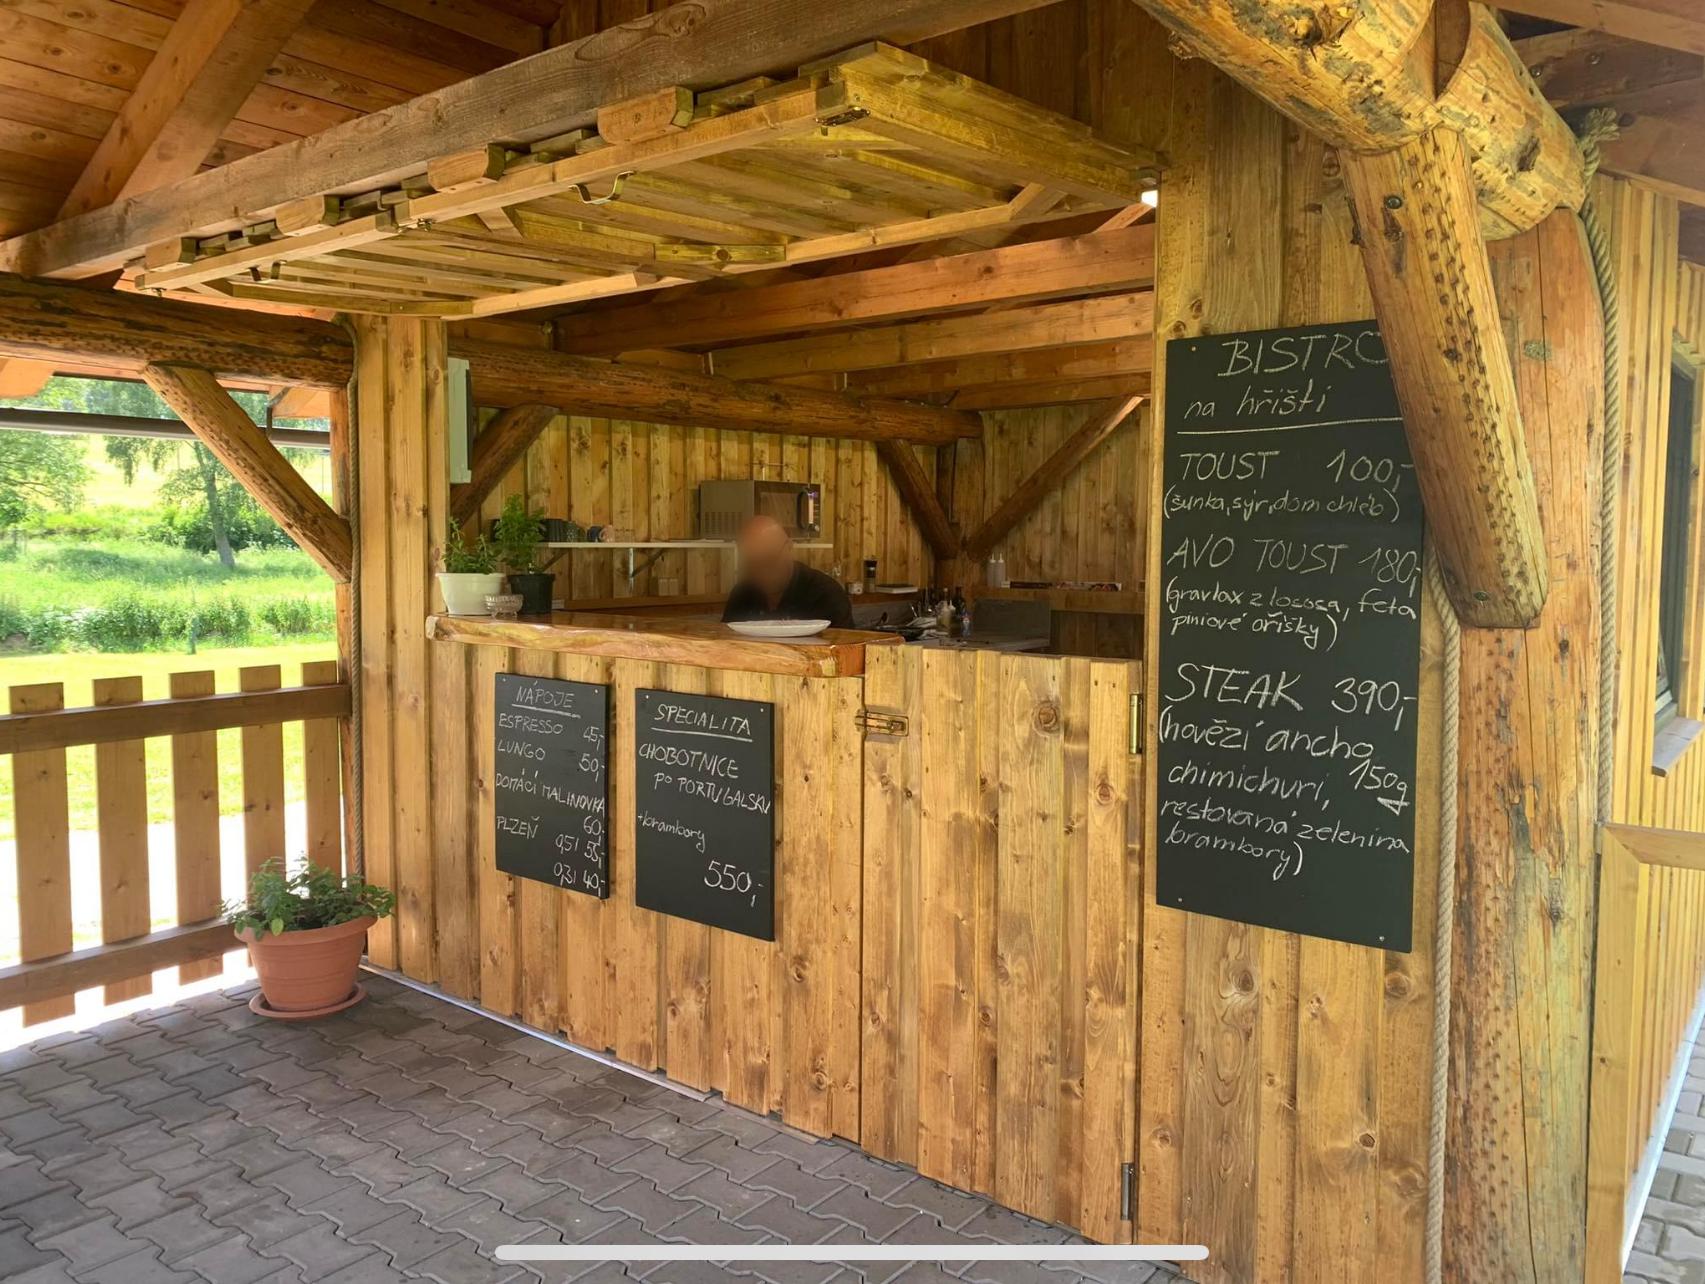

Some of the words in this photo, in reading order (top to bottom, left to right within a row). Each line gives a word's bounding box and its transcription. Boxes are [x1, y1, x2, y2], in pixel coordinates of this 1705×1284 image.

[1184, 400, 1215, 419] na
[1180, 450, 1280, 480] TOUST
[1166, 533, 1235, 569] AVO
[1253, 538, 1349, 575] TOUST
[1166, 575, 1244, 614] (gravlax
[1250, 594, 1263, 607] z
[1358, 588, 1417, 620] feta
[1170, 611, 1248, 636] piniové
[516, 680, 575, 708] NÁPOJE
[1164, 663, 1303, 711] STEAK
[498, 712, 564, 734] ESPRESSO
[654, 703, 751, 736] SPECIALITA
[497, 739, 546, 761] LUNGO
[1265, 725, 1375, 759] ancho
[638, 743, 740, 779] CHOBOTNICE
[542, 784, 605, 819] MALINOVKA
[677, 777, 772, 815] PORTUGALSKU
[496, 816, 541, 840] PLZEŇ
[1296, 819, 1410, 854] zelenina
[1164, 820, 1303, 881] brambory)
